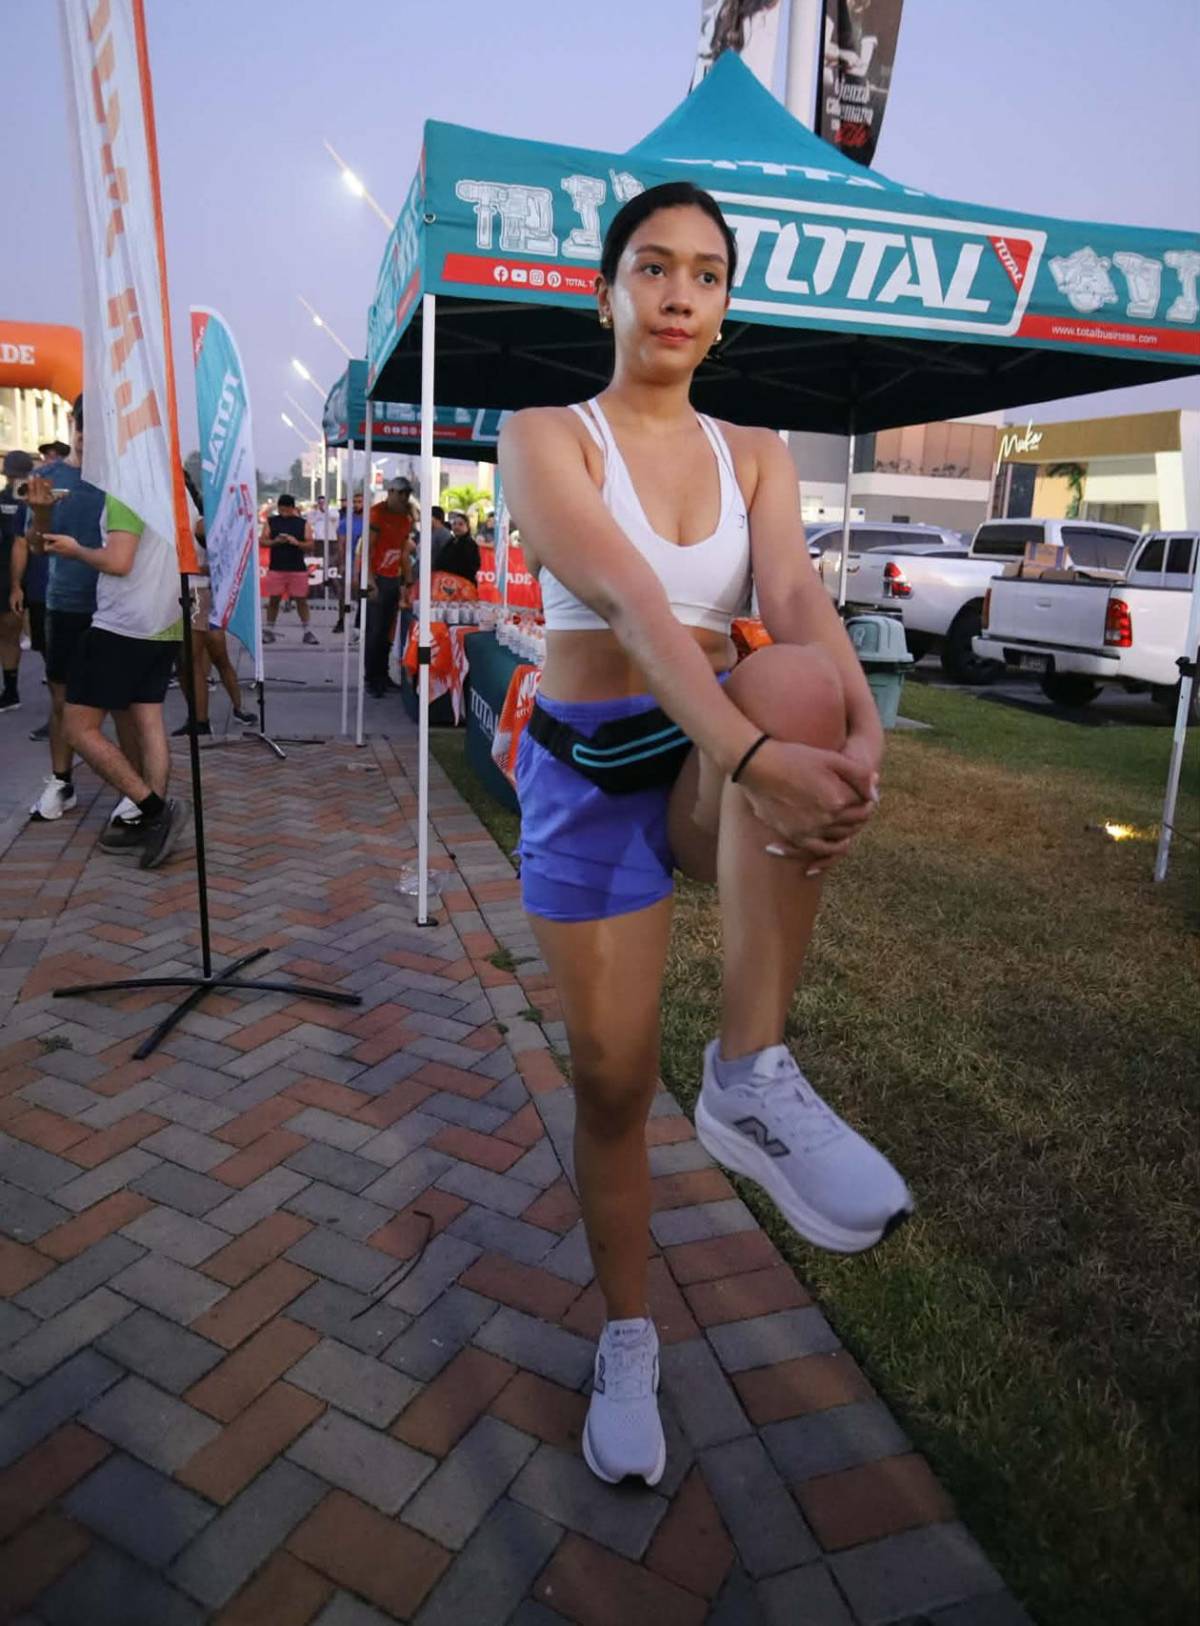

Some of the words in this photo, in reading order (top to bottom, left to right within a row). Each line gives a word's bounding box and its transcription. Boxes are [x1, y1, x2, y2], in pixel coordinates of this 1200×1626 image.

[723, 214, 991, 312] TOTAL
[995, 239, 1023, 284] TOTAL
[0, 343, 36, 366] DE
[476, 570, 533, 585] TOADE
